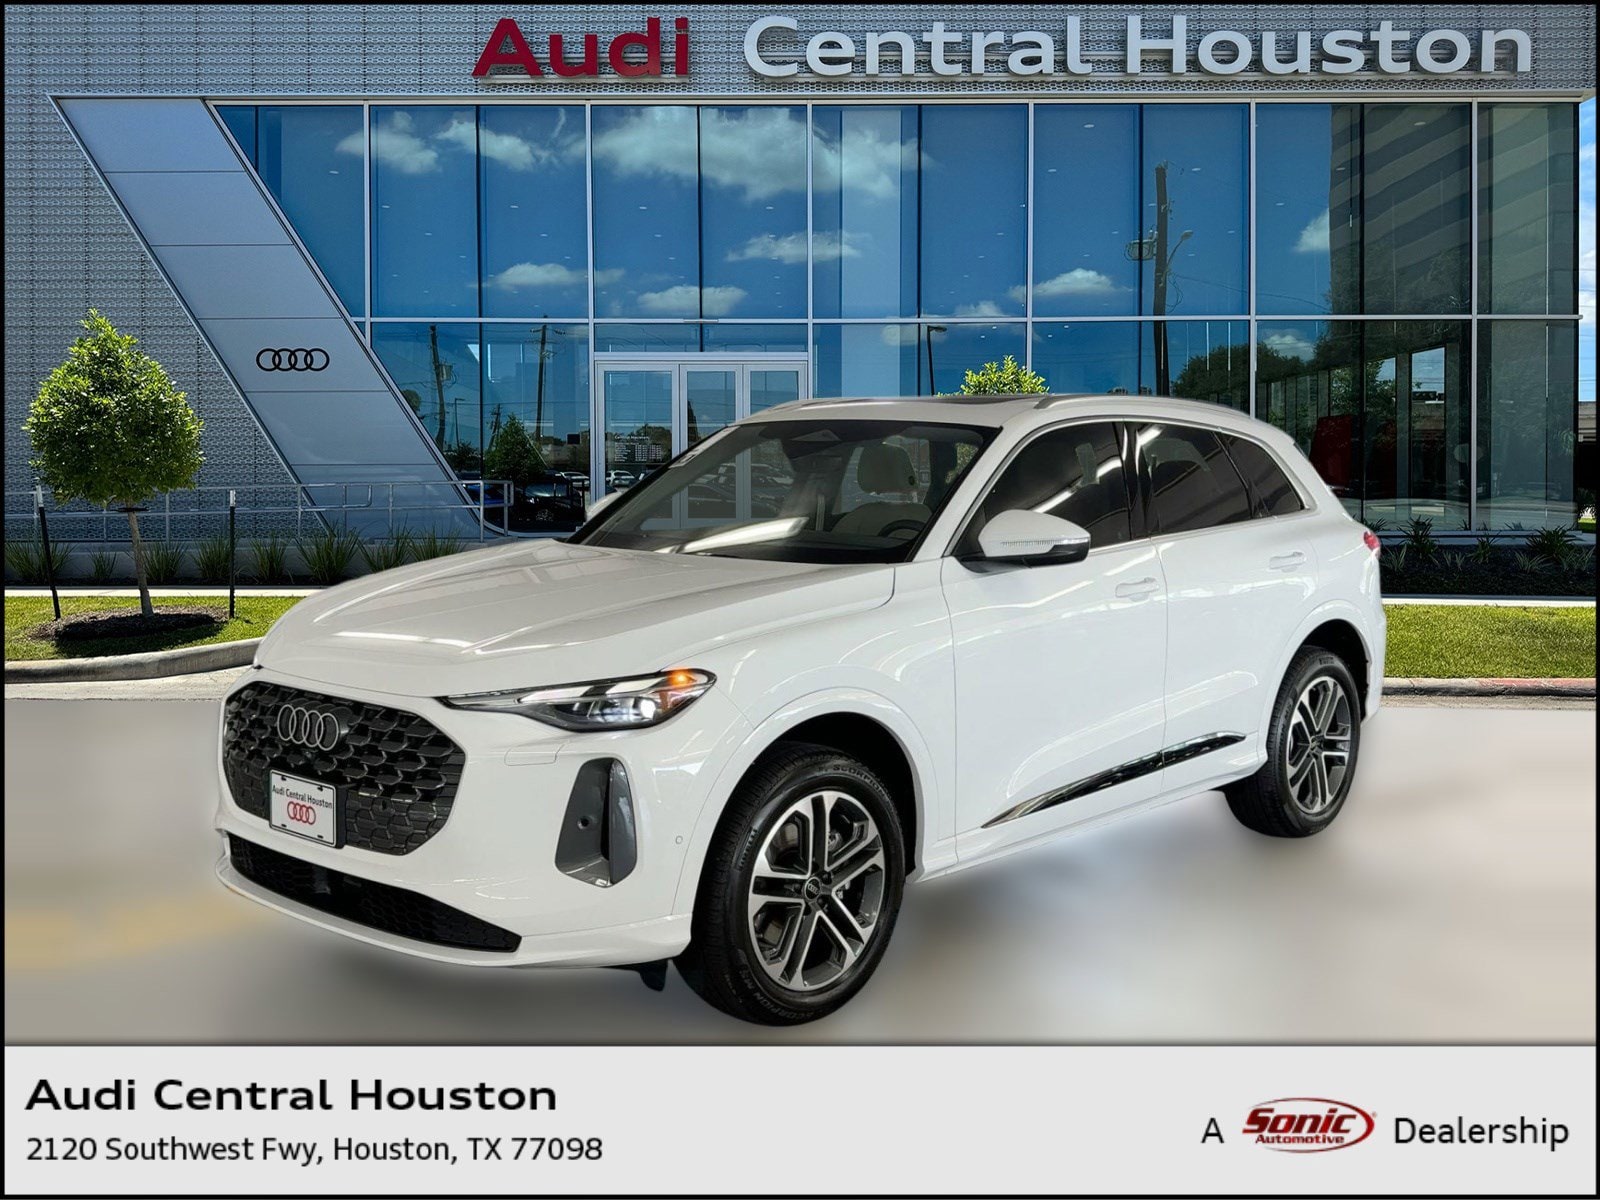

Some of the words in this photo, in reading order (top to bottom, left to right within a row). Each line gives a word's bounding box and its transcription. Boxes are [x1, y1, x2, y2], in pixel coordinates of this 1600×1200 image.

[472, 17, 690, 78] Audi
[744, 15, 1092, 78] Central
[1127, 15, 1532, 75] Houston
[272, 784, 285, 796] Audi
[286, 788, 307, 802] Central
[307, 794, 333, 809] Houston
